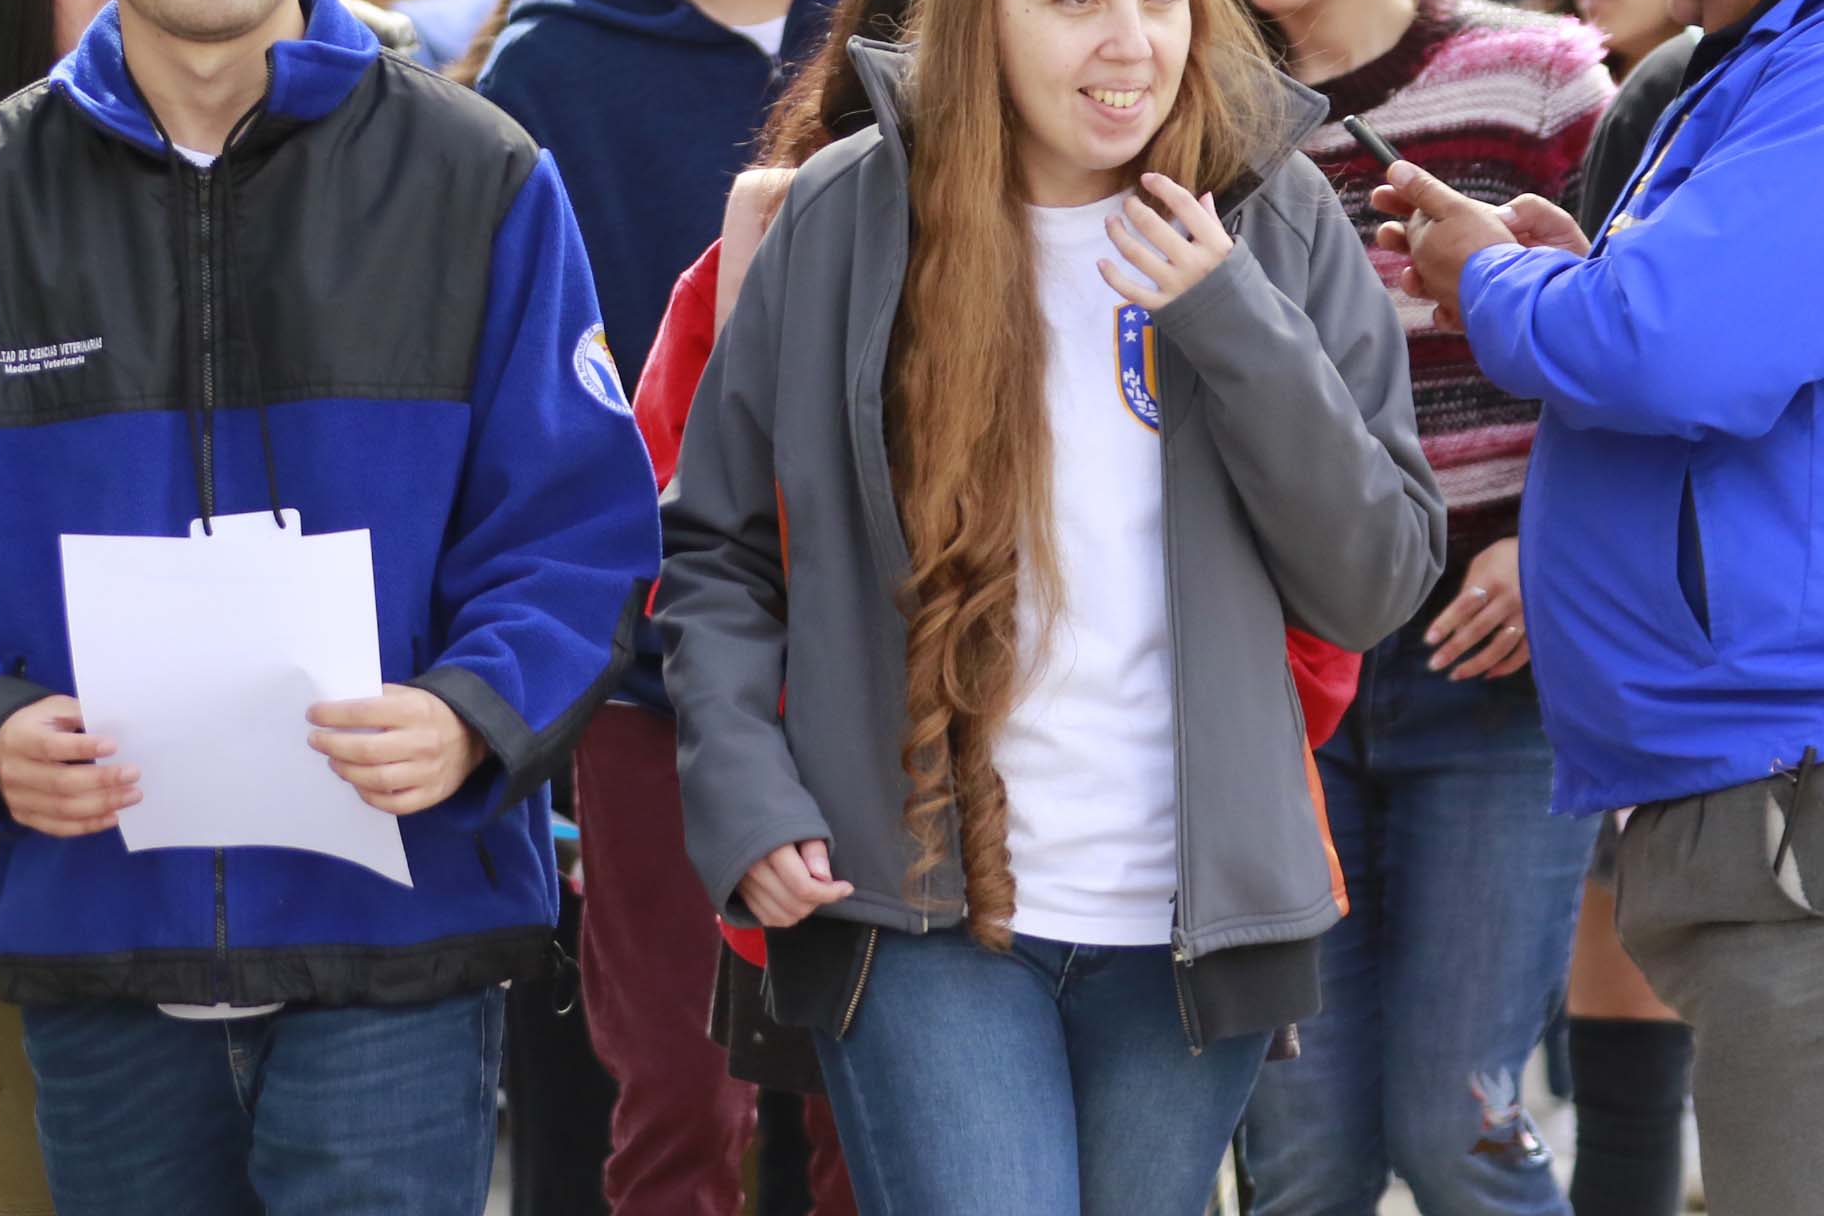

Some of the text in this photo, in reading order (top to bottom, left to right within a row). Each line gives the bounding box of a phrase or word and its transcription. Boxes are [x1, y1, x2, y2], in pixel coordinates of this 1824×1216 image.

[18, 349, 28, 362] DE
[29, 344, 58, 361] CIENCIAS
[59, 337, 103, 356] VETERINARIAS
[4, 355, 85, 374] Medicina Veterinaria
